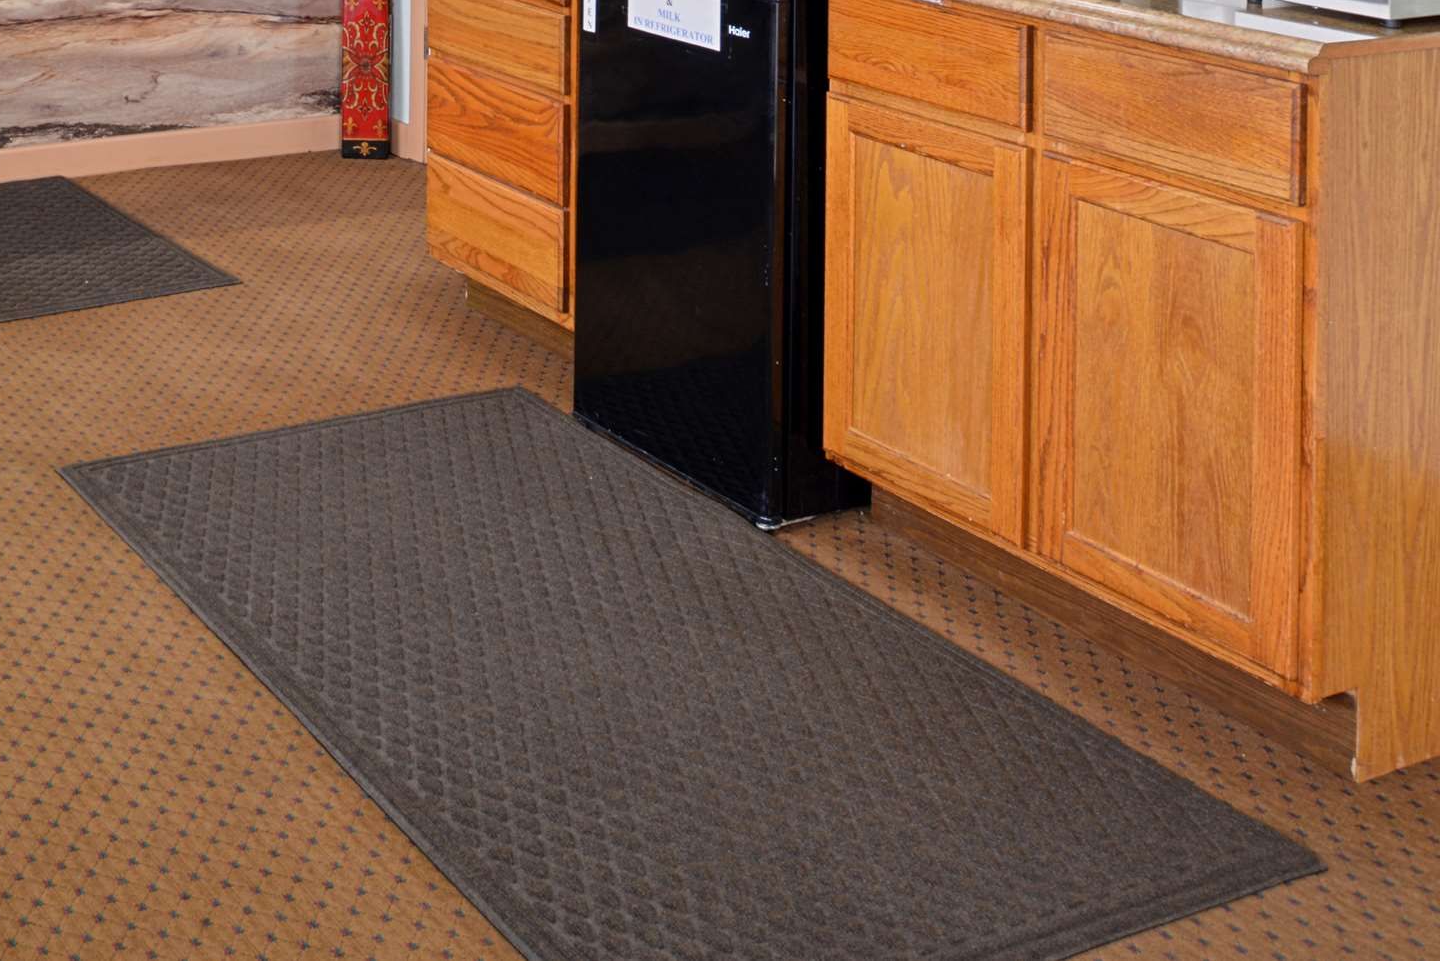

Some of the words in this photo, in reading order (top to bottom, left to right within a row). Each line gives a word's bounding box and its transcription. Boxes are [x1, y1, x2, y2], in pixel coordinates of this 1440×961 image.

[657, 8, 681, 22] MILK
[633, 16, 643, 26] IN
[644, 19, 714, 45] REFRIGERATOR
[728, 24, 751, 39] Haier
